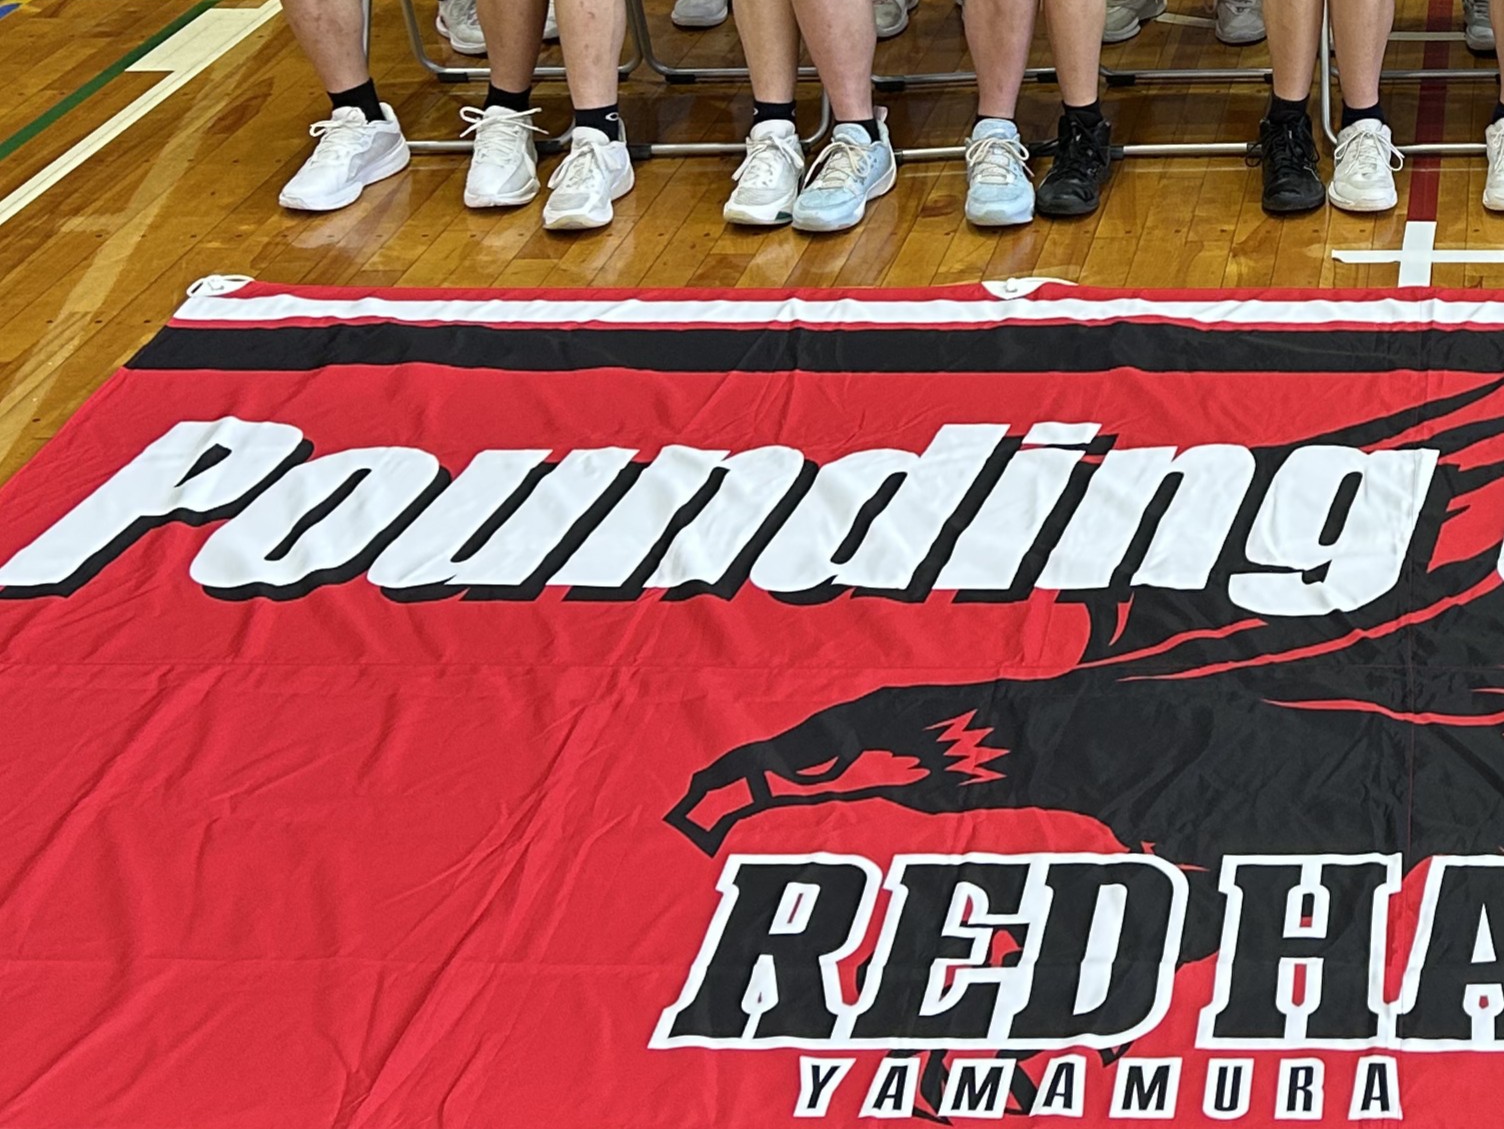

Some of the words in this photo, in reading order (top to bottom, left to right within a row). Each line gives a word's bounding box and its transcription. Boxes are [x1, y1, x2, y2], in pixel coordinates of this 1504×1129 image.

[0, 416, 1440, 616] Pounding
[648, 853, 1190, 1051] RED
[793, 1054, 1404, 1122] YAMAMURA
